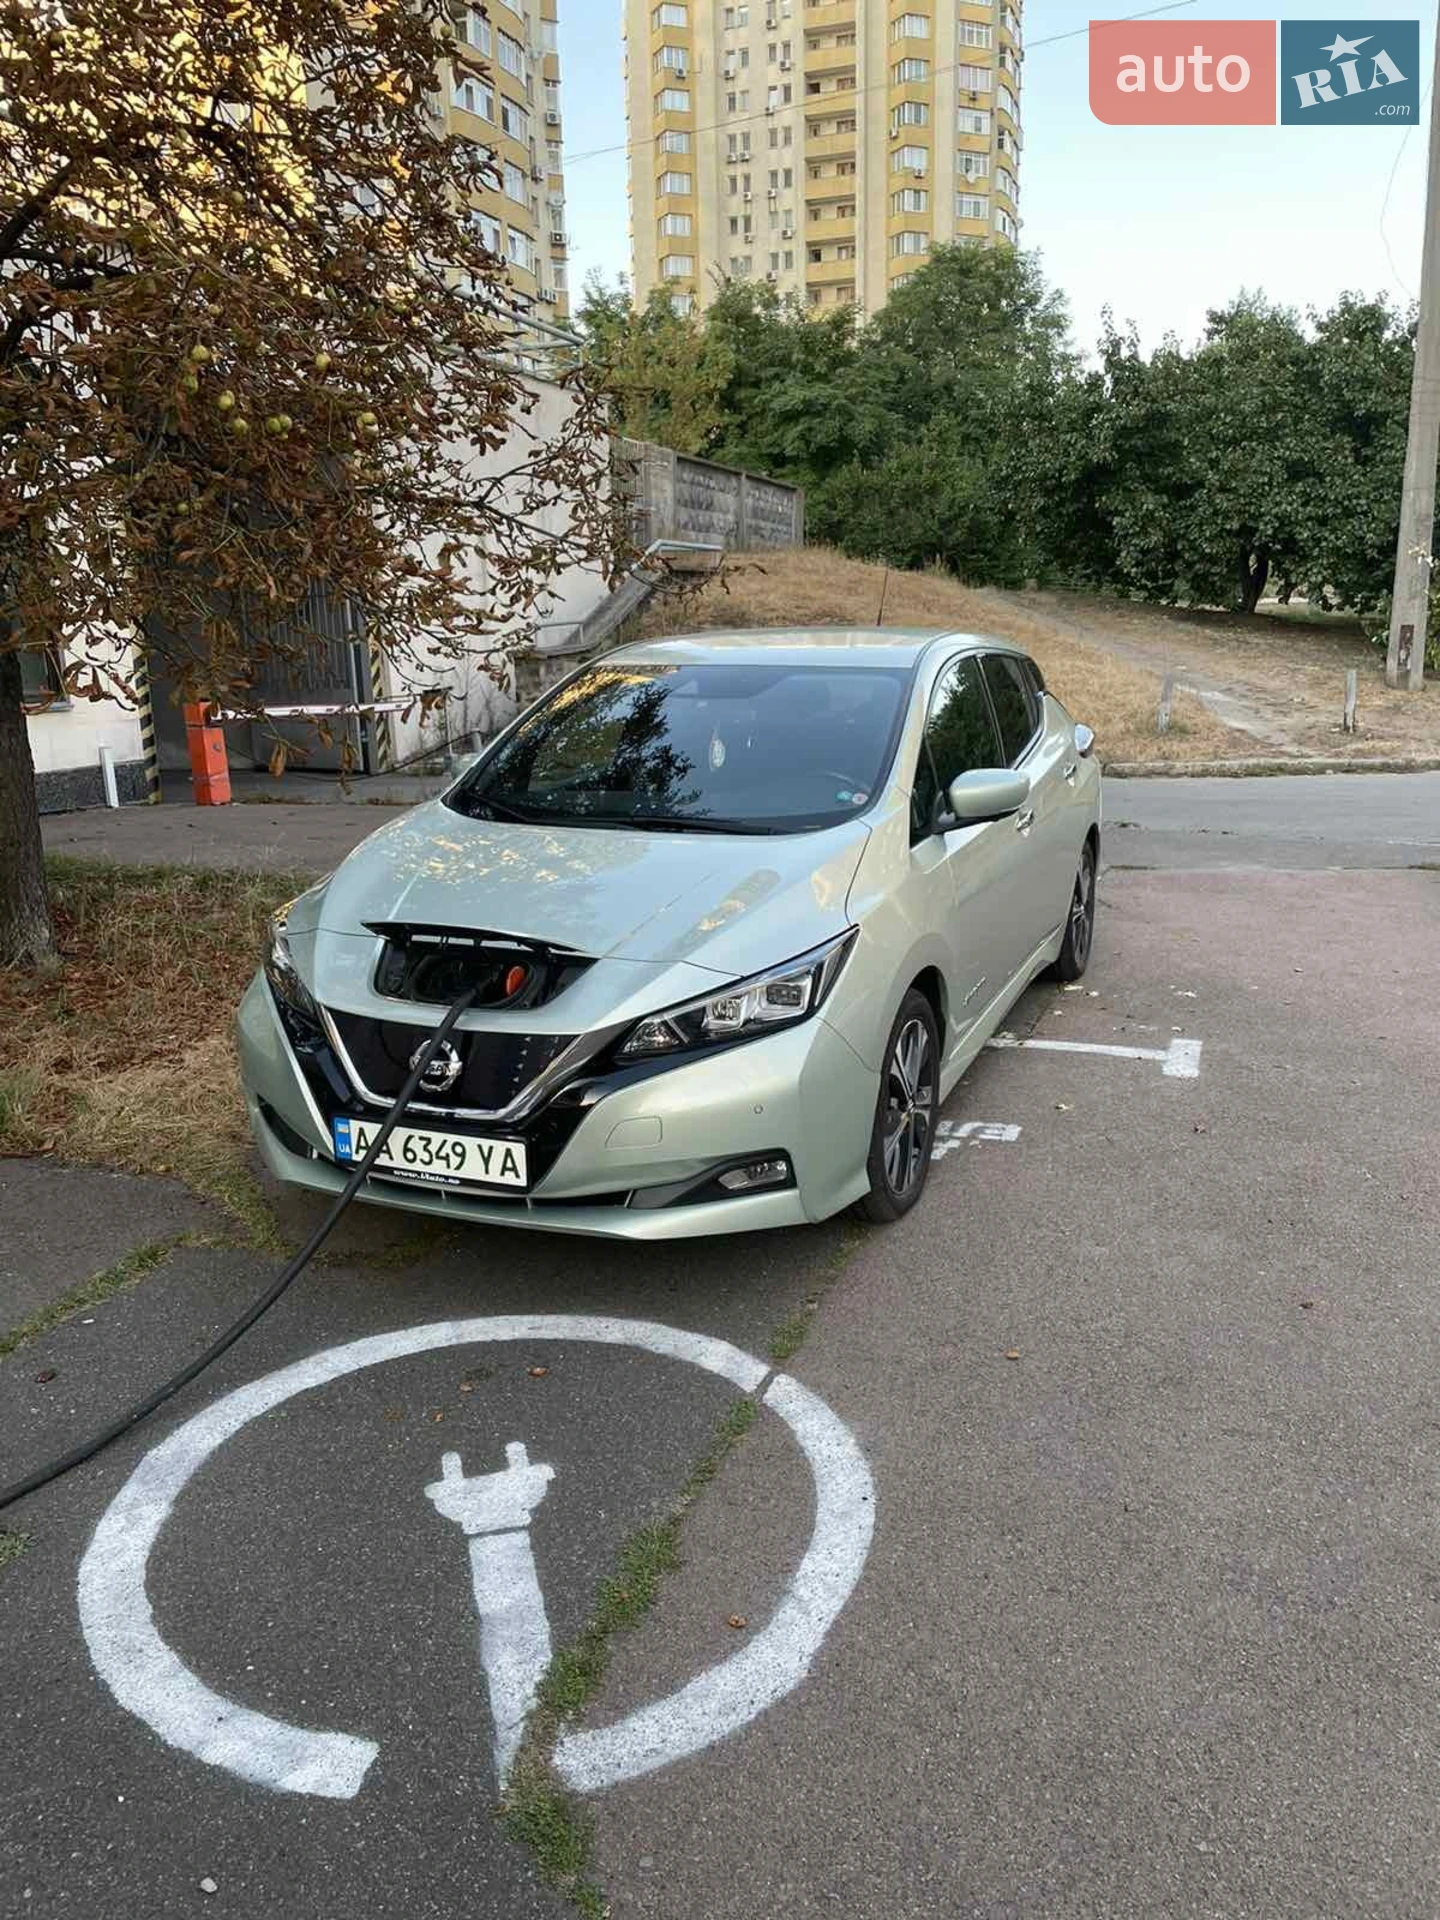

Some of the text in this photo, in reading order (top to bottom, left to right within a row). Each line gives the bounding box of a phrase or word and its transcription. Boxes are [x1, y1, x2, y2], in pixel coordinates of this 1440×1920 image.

[338, 1143, 351, 1153] UA
[402, 1134, 467, 1171] 6349
[477, 1143, 521, 1179] YA
